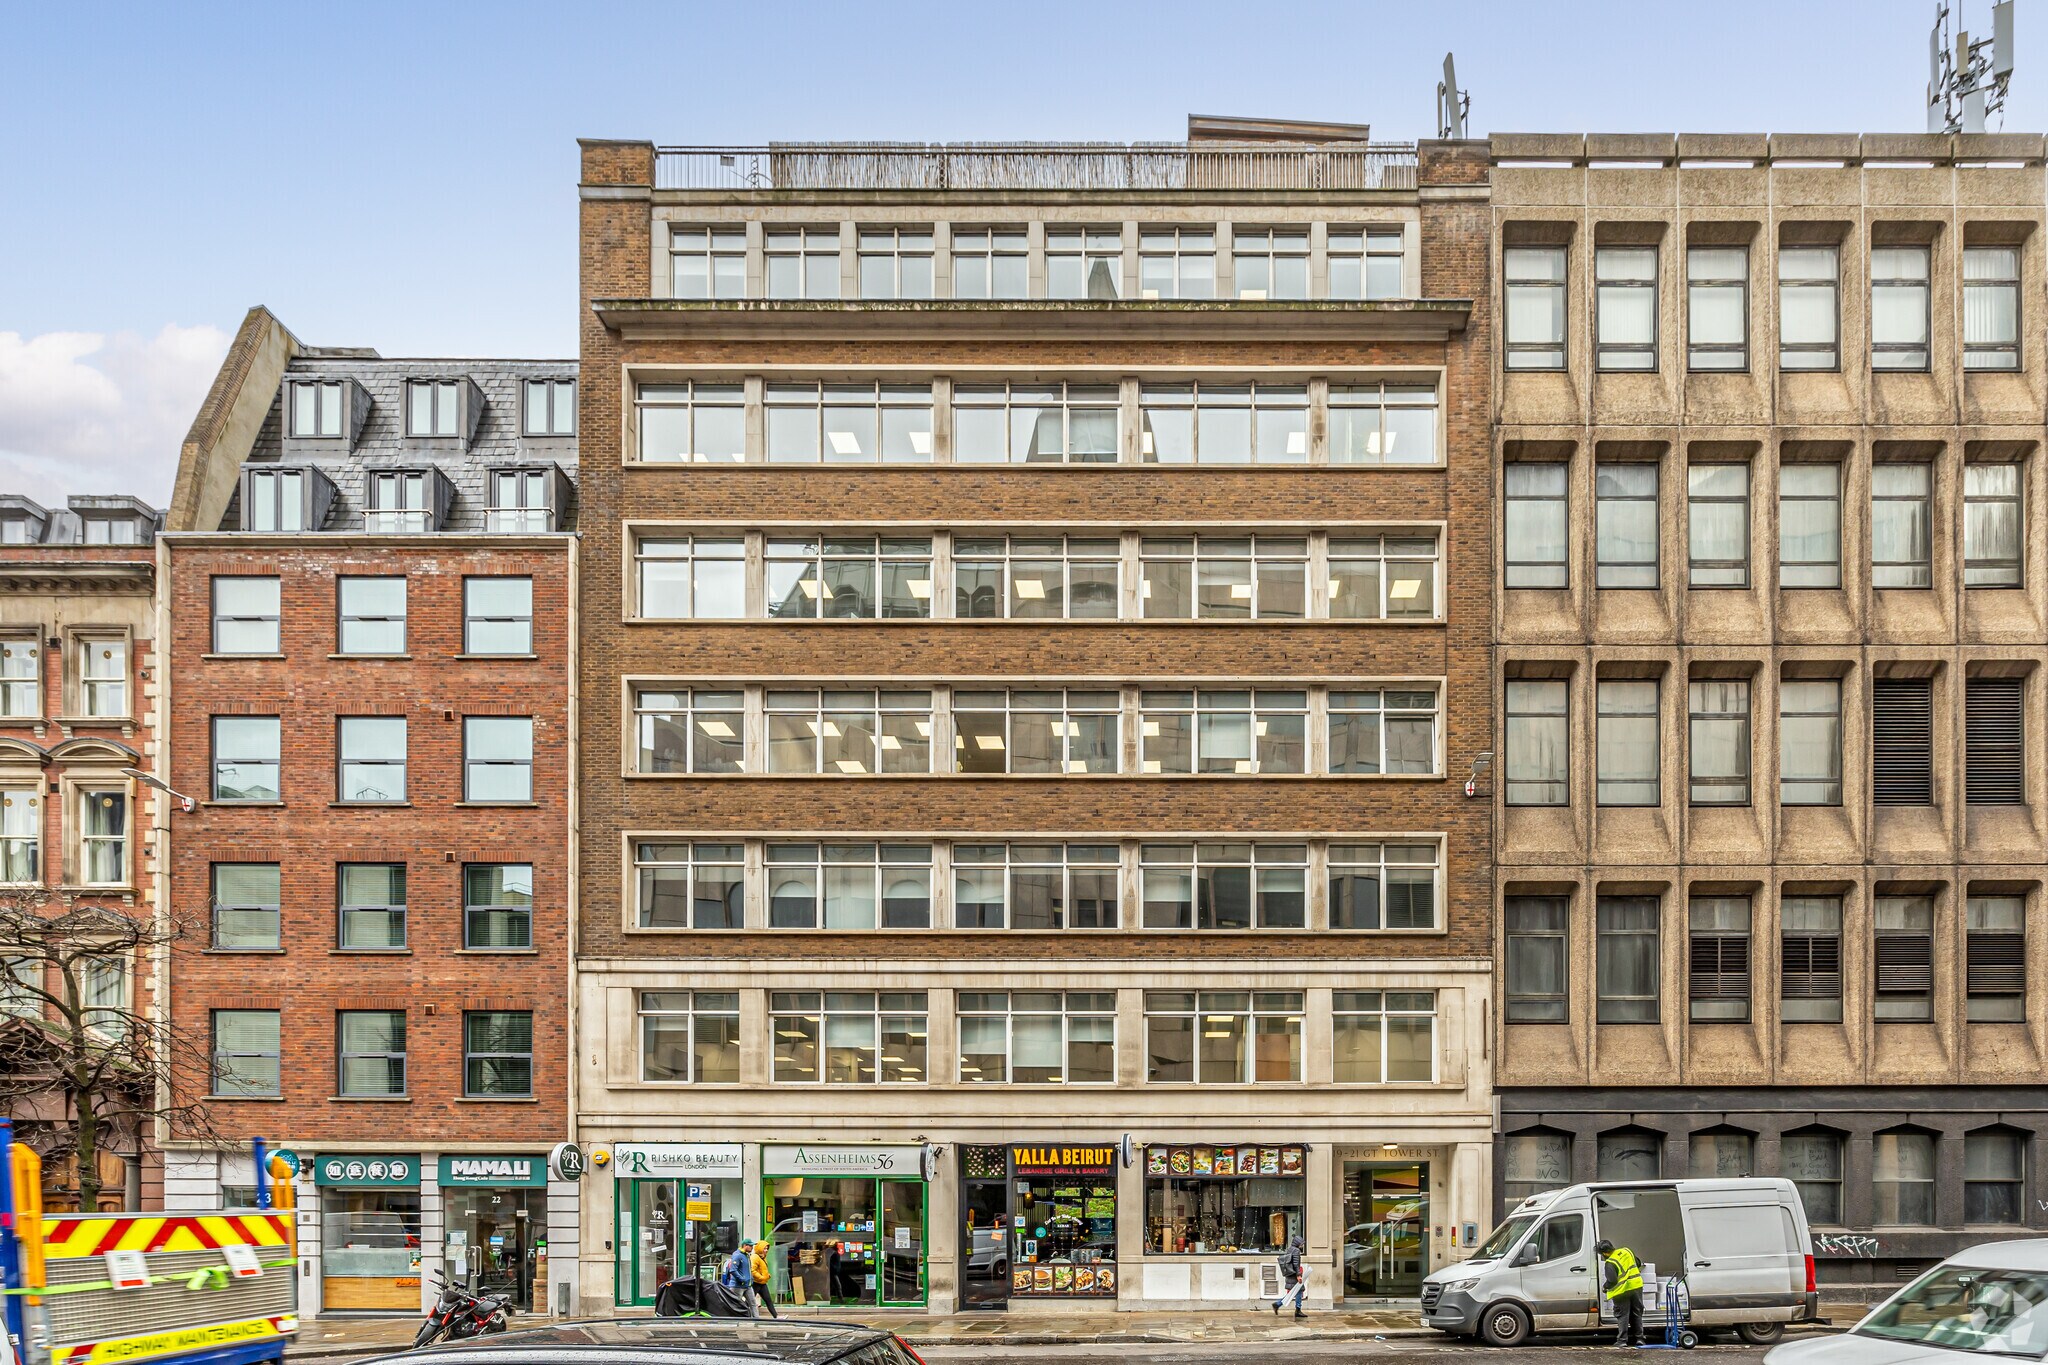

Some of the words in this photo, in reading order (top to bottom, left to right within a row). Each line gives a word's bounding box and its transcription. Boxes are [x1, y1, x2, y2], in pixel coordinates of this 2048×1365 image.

[651, 1154, 692, 1163] RISHKO
[695, 1154, 738, 1163] BEAUTY
[1013, 1148, 1060, 1165] YALLA
[1062, 1148, 1114, 1165] BEIRUT
[1363, 1148, 1379, 1158] GT
[1383, 1148, 1422, 1158] TOWER
[1426, 1148, 1440, 1158] ST.
[451, 1160, 513, 1175] MAMA
[629, 1151, 652, 1173] R
[873, 1153, 895, 1170] 56
[1017, 1167, 1053, 1175] LEBANESE
[1054, 1167, 1074, 1175] GRILL
[1081, 1167, 1109, 1175] BAKERY
[689, 1187, 699, 1197] P
[491, 1196, 501, 1204] 22
[177, 1322, 264, 1346] MAINTENANCE
